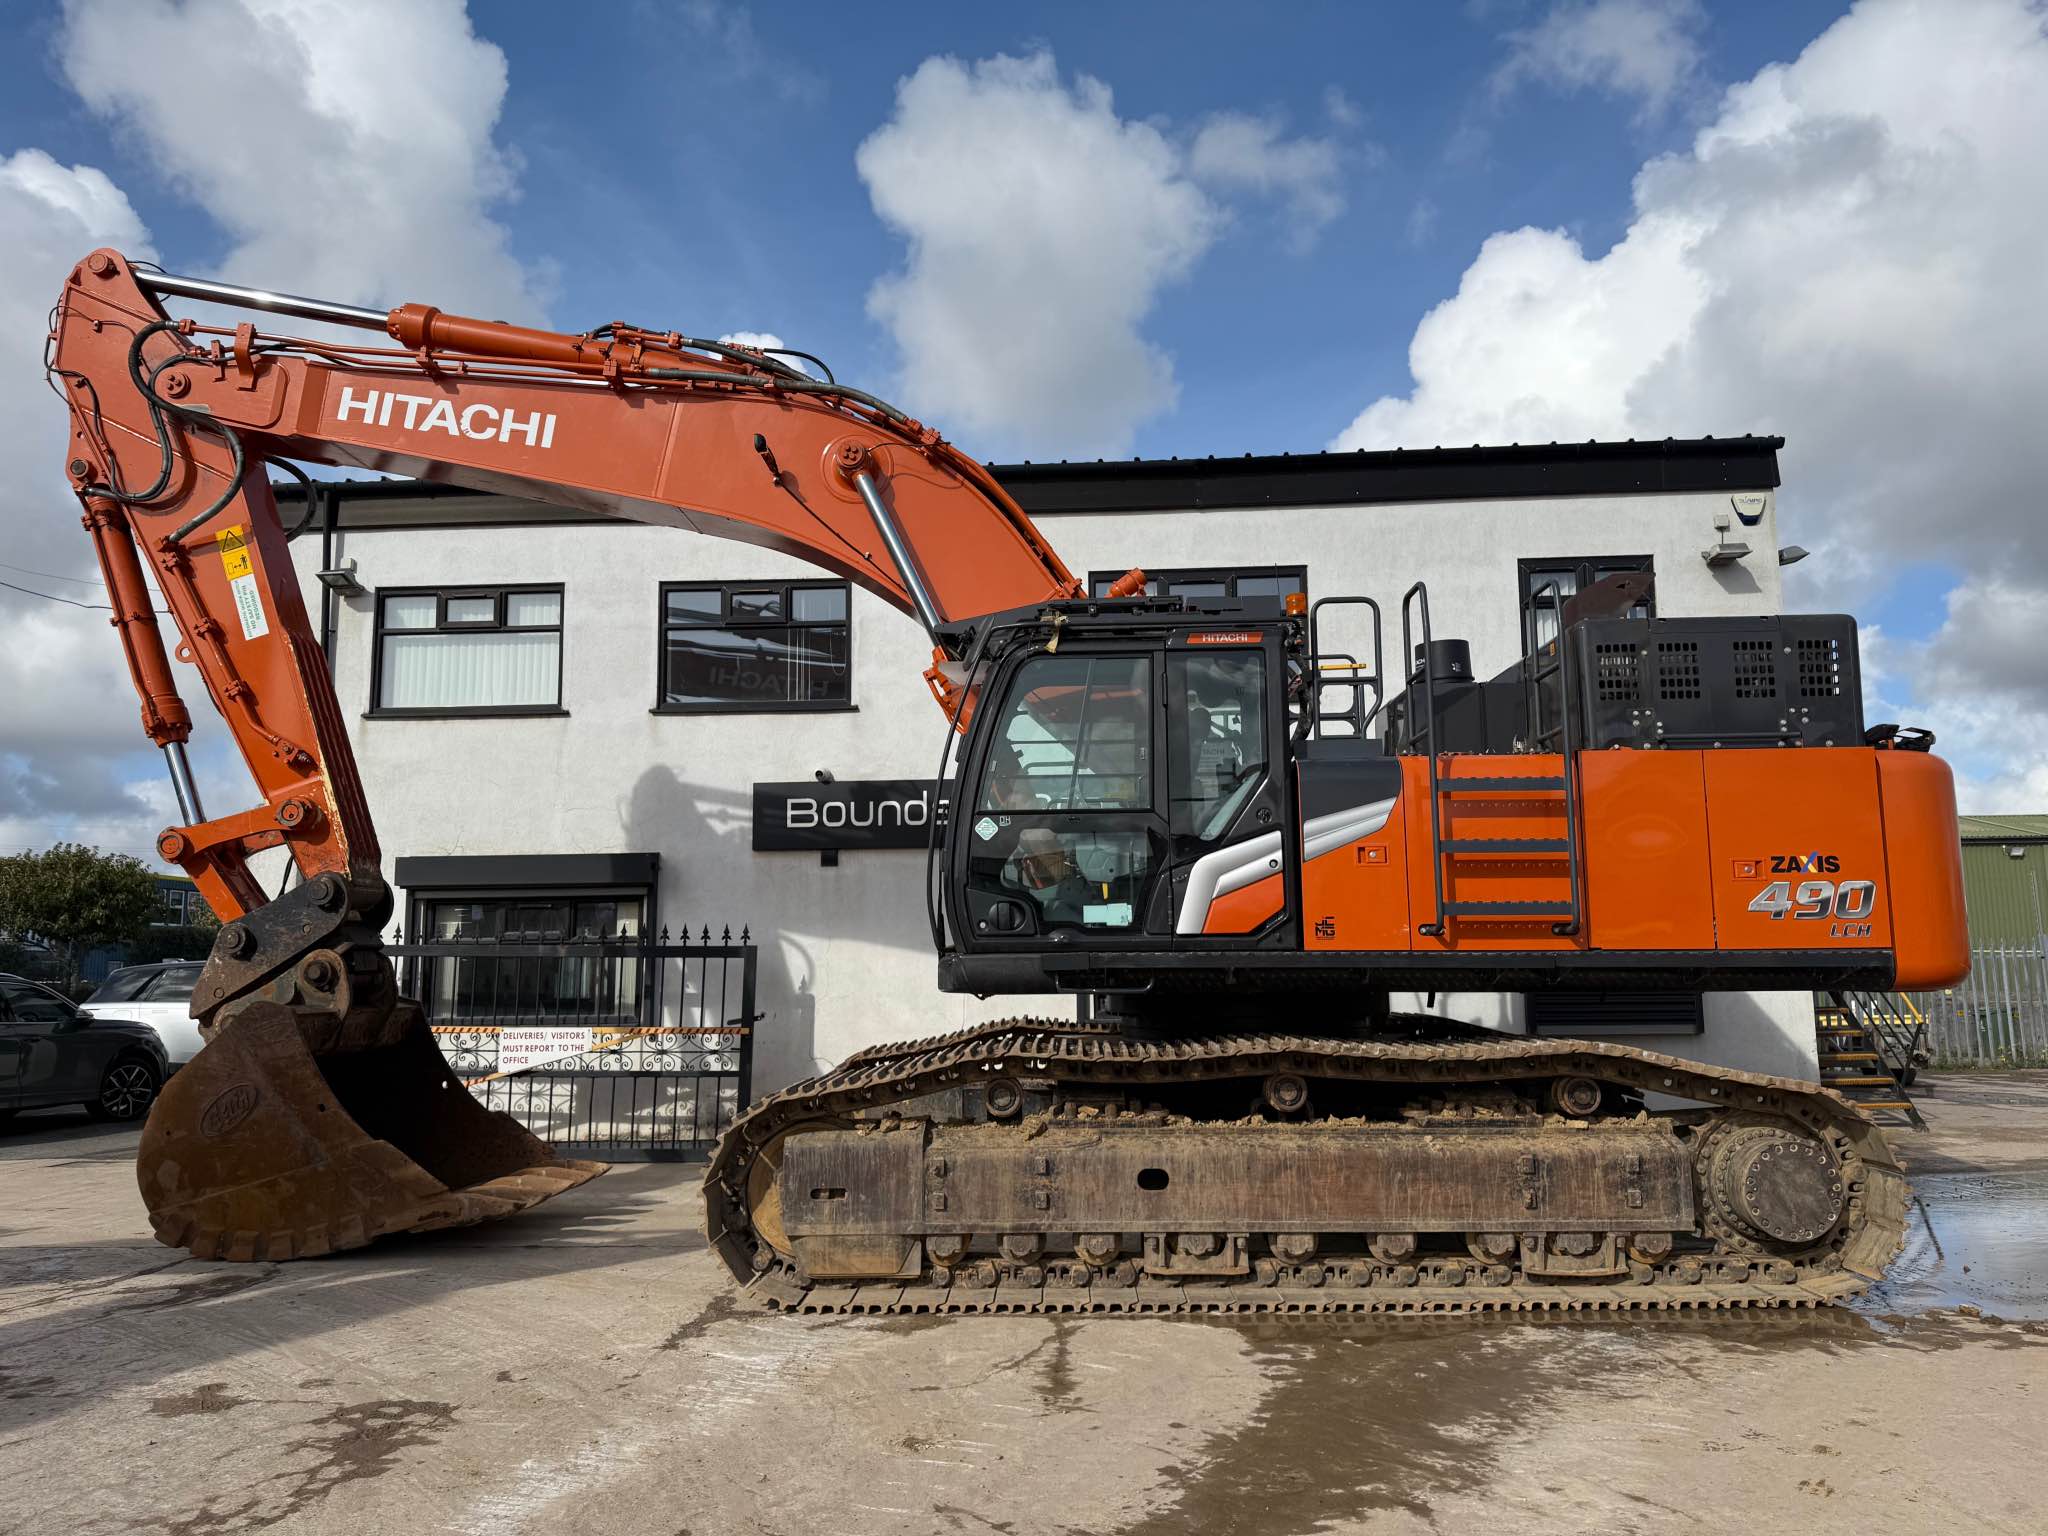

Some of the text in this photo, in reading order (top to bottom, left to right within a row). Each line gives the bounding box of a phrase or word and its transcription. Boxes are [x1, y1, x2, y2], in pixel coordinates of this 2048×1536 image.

[337, 387, 557, 448] HITACHI
[244, 597, 255, 619] SAFETY
[1202, 633, 1248, 642] HITACHI
[1770, 851, 1841, 873] ZAXIS
[1747, 880, 1877, 920] 490
[1829, 923, 1873, 938] LCH
[551, 1031, 585, 1039] VISITORS
[502, 1044, 585, 1053] MUST REPORT TO THE
[502, 1056, 529, 1064] OFFICE
